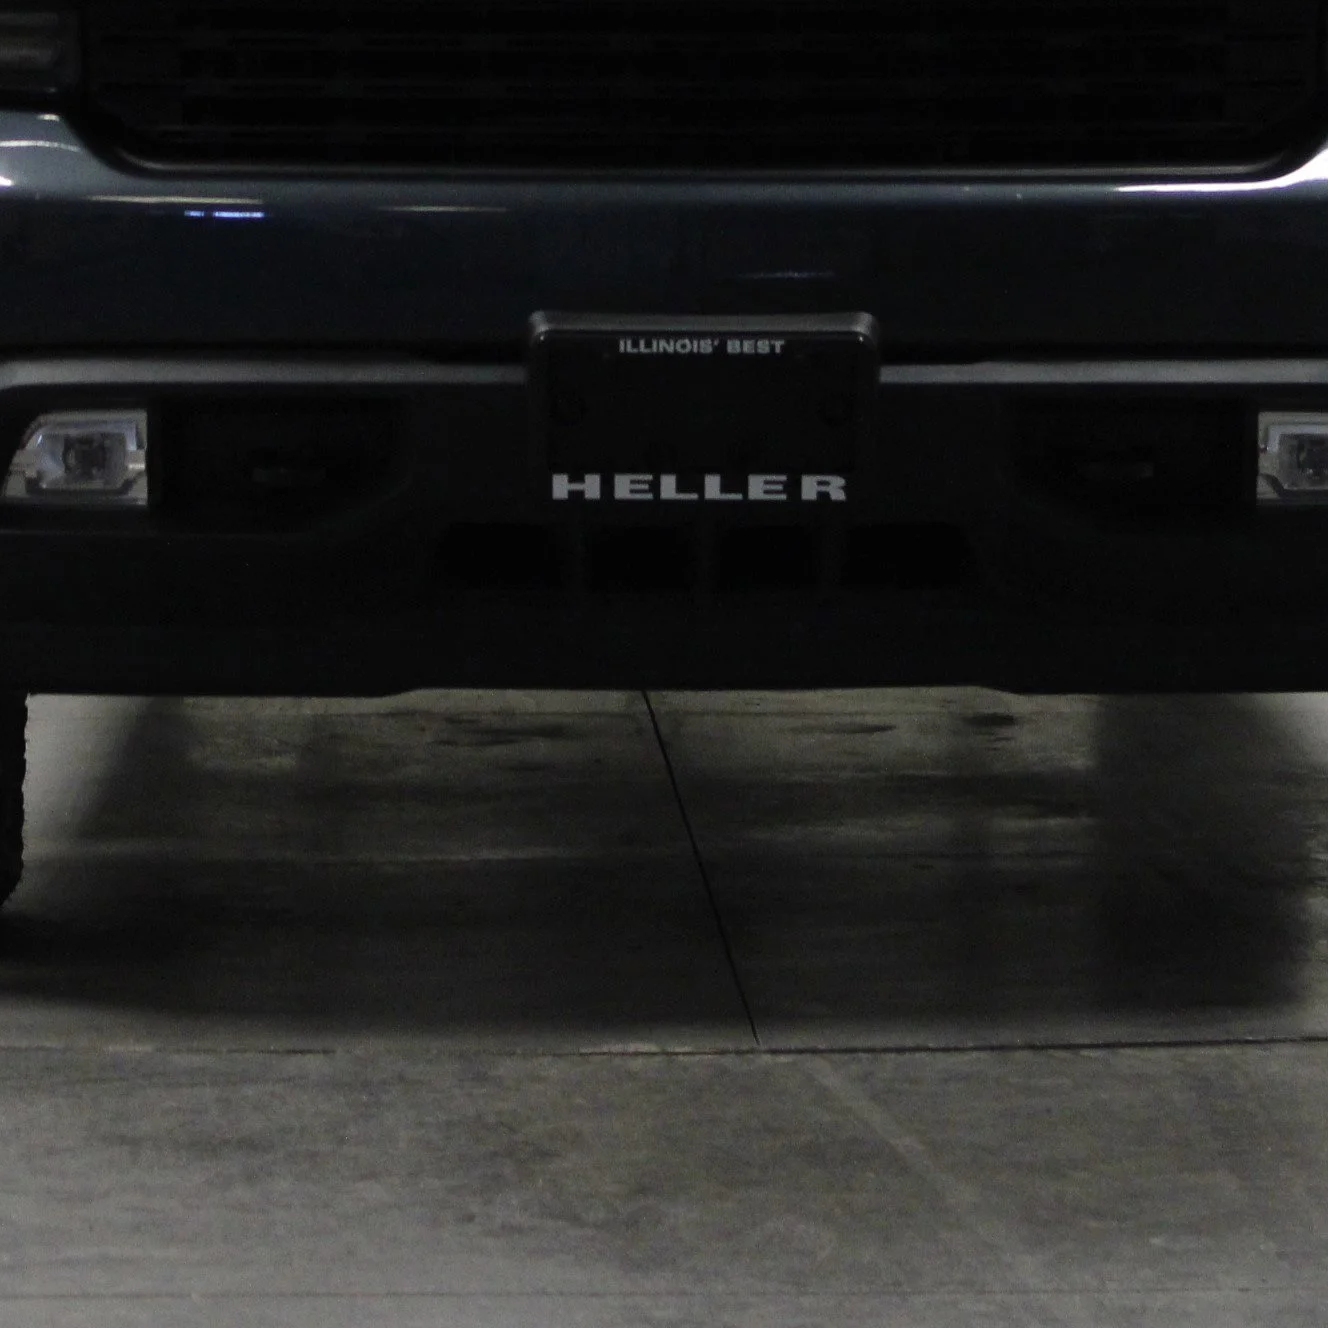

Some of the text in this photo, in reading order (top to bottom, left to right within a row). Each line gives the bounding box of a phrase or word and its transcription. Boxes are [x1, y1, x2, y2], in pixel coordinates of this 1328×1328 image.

[618, 338, 785, 354] ILLINOIS' BEST
[551, 473, 847, 501] HELLER
